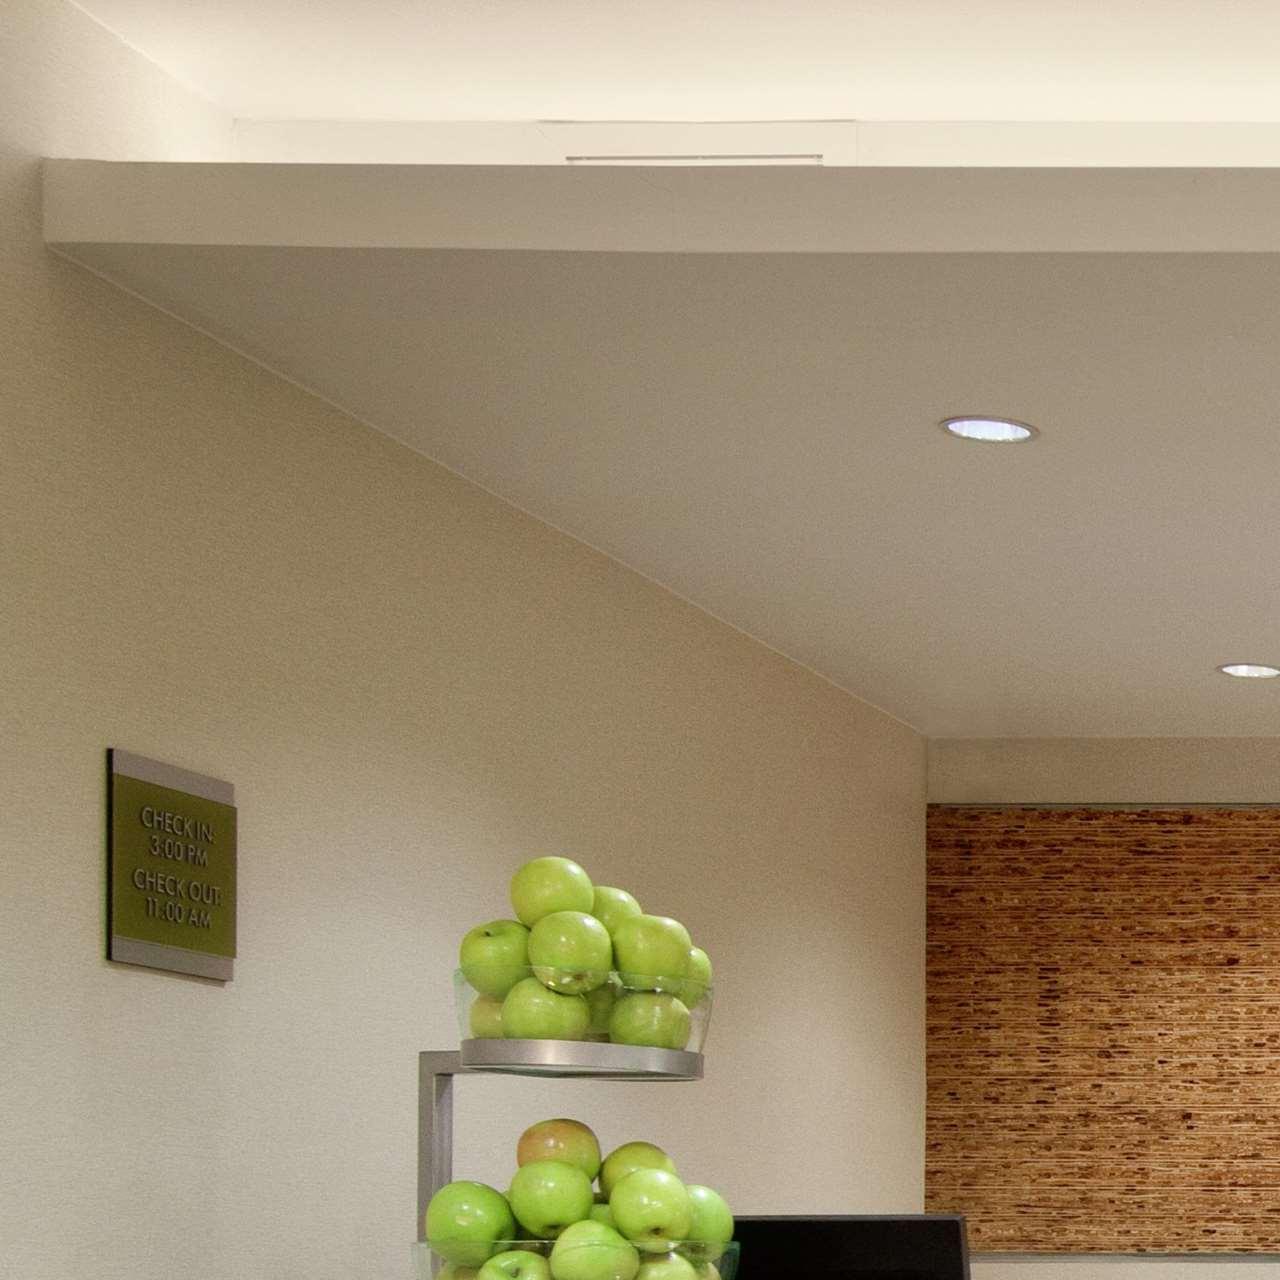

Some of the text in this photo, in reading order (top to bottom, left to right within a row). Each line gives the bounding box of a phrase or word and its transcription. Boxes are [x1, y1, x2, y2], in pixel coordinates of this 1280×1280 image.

[141, 806, 193, 839] CHECK
[150, 835, 208, 867] 3:00 PM
[133, 868, 186, 897] CHECK
[146, 896, 212, 928] 11:00 AM
